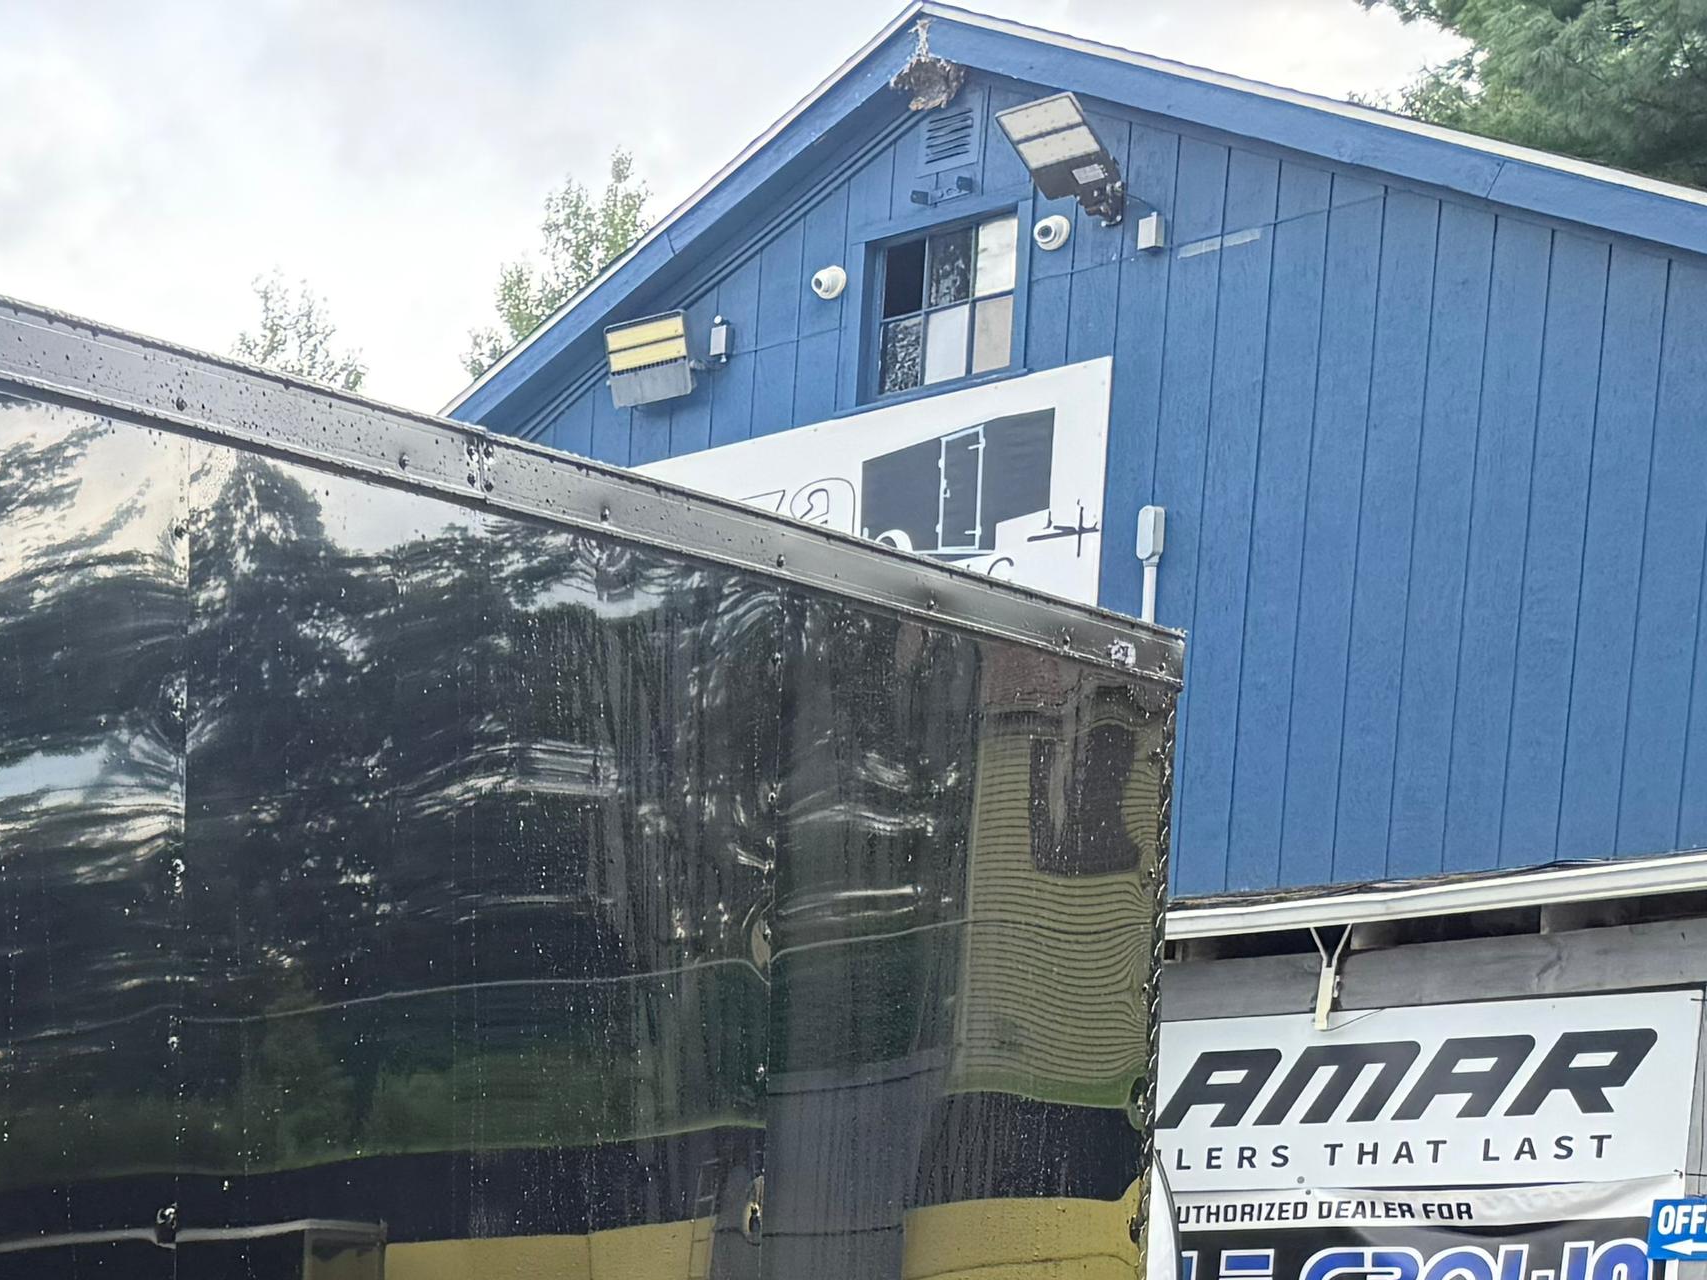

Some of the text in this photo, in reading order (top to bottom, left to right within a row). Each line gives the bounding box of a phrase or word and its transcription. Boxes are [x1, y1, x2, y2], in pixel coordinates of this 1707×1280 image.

[1154, 1028, 1658, 1129] AMAR
[1154, 1134, 1612, 1170] LERS THAT LAST
[1177, 1200, 1474, 1224] UTHORIZED DEALER FOR
[1657, 1205, 1707, 1235] OFF
